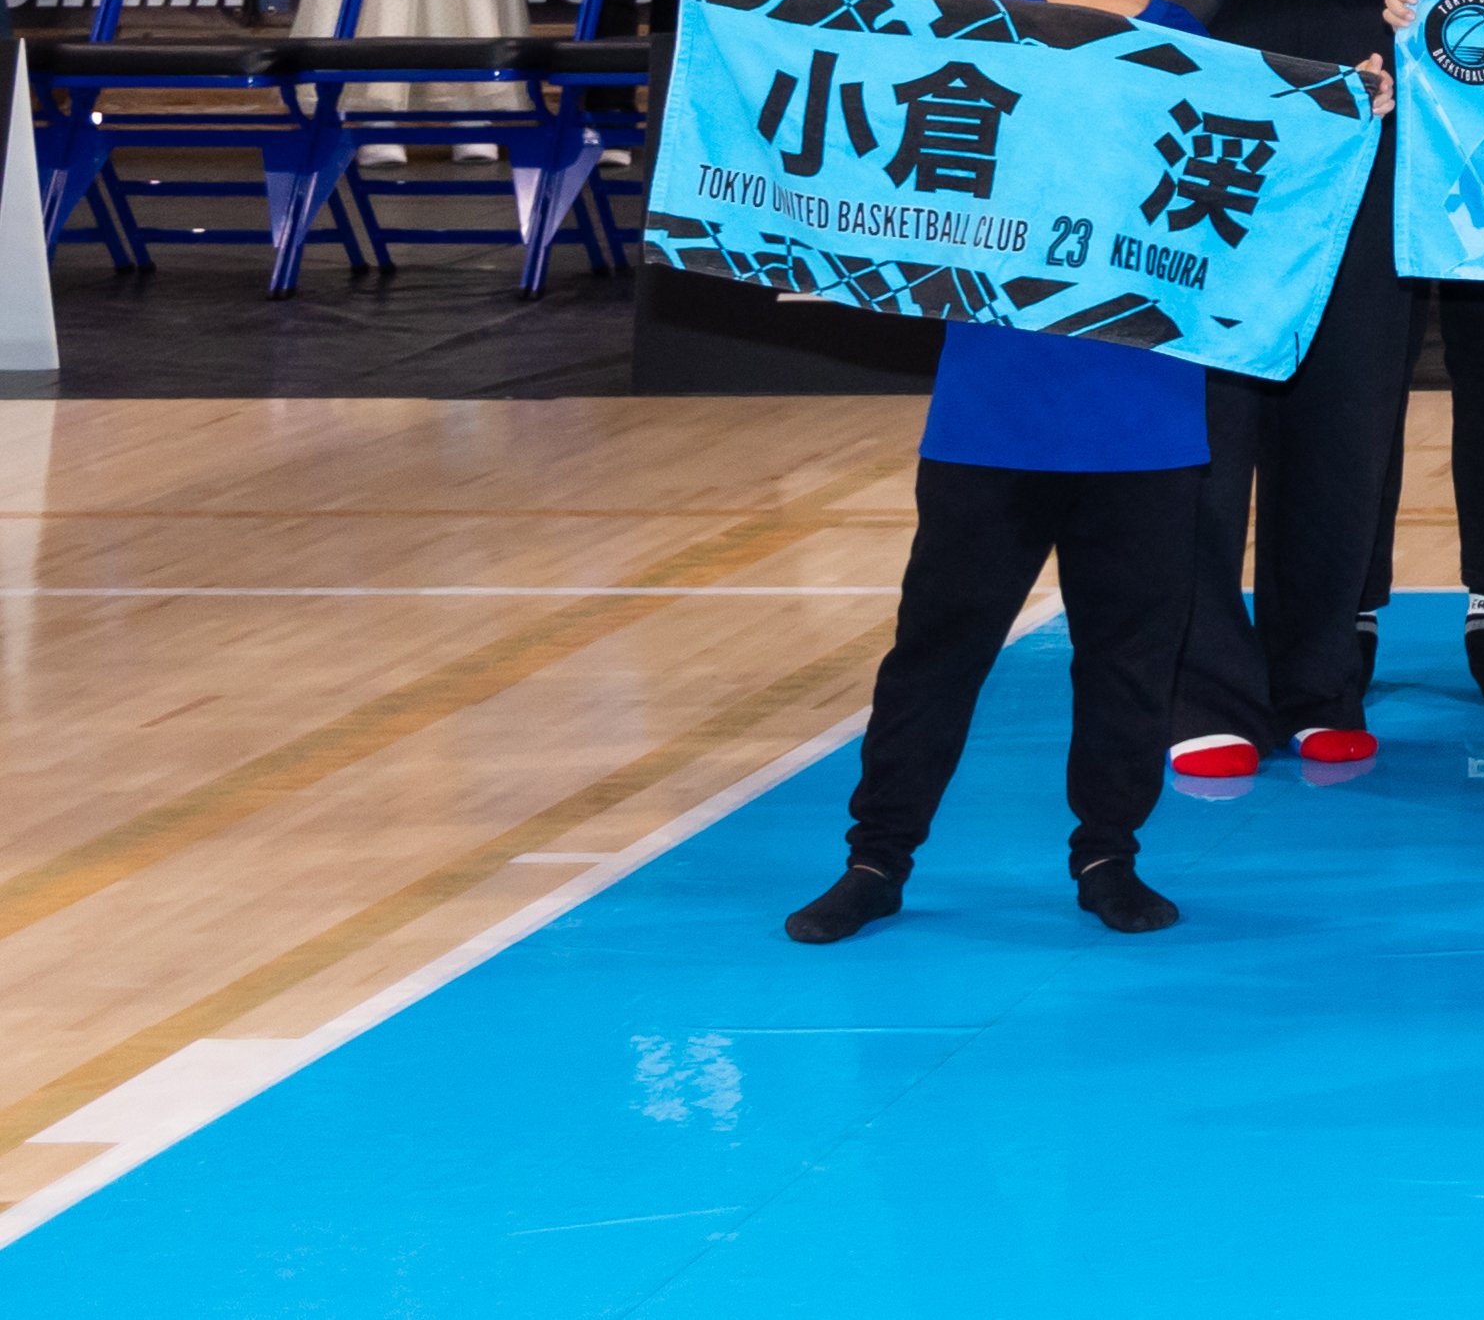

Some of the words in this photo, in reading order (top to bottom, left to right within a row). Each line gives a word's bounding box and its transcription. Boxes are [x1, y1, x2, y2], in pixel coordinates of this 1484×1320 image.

[698, 164, 768, 209] TOKYO
[772, 179, 832, 232] UNITED
[837, 199, 970, 247] BASKETBALL
[972, 213, 1029, 254] CLUB
[1045, 214, 1094, 269] 23
[1109, 233, 1142, 272] KEI
[1144, 245, 1210, 293] OGURA
[755, 48, 1021, 200] 小倉
[1140, 98, 1280, 250] 渓
